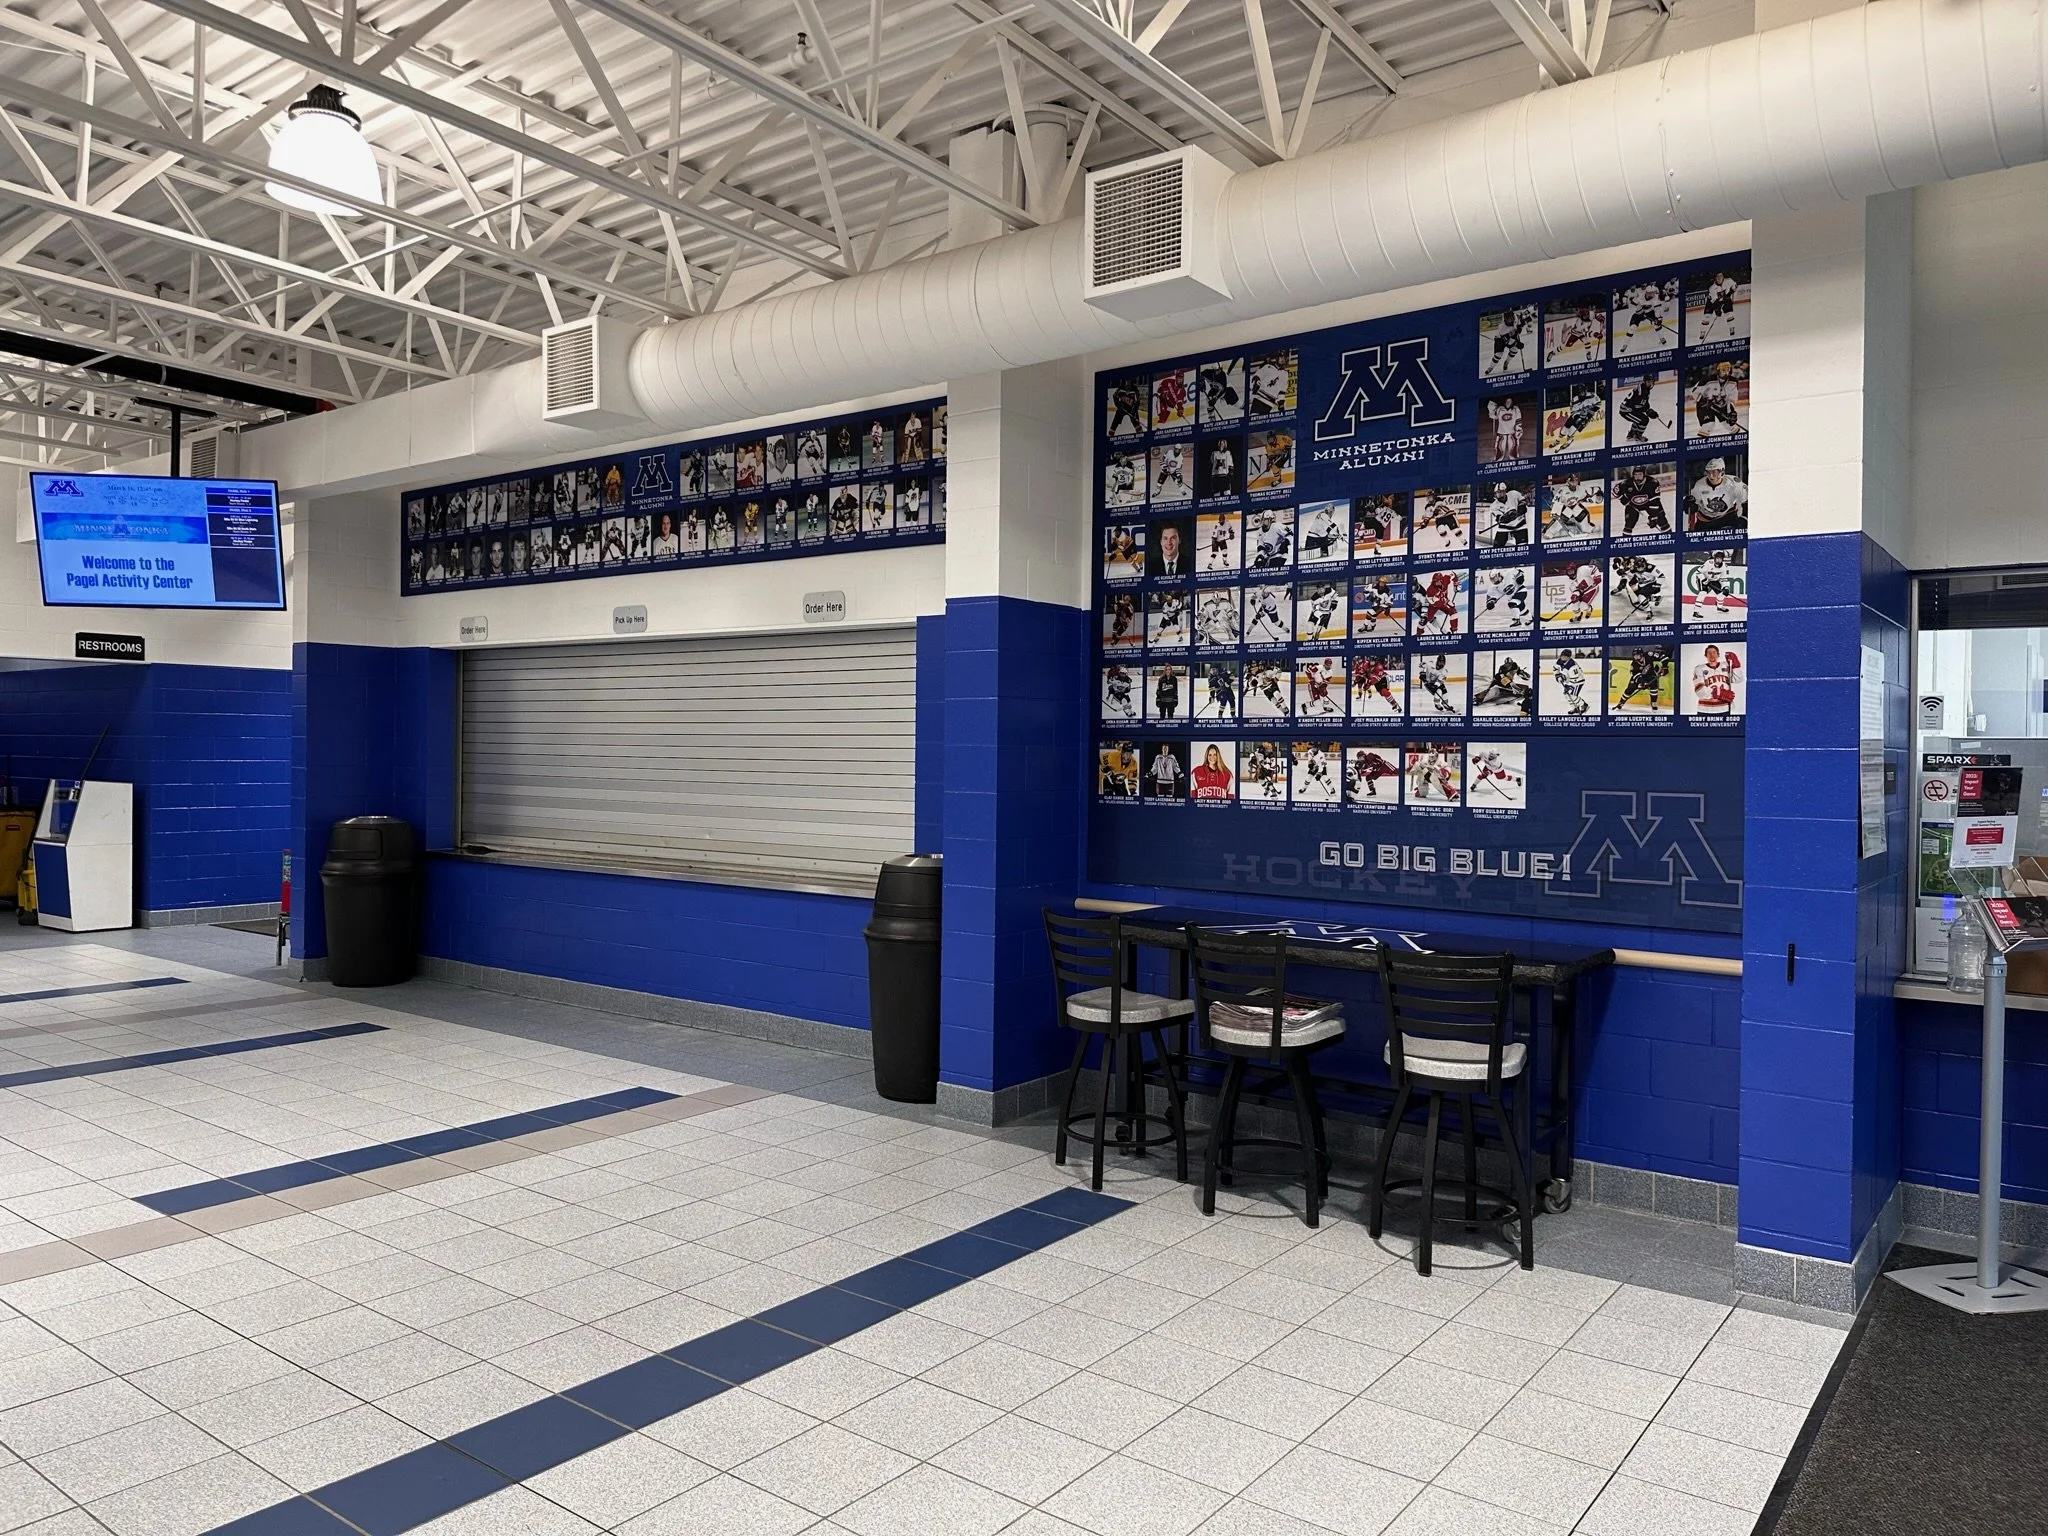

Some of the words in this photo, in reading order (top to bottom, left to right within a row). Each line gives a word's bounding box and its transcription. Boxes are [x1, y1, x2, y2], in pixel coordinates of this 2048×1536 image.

[1688, 350, 1715, 358] UNIVERSITY
[1547, 371, 1571, 379] UNIVERSITY
[1314, 432, 1455, 461] MINNETONKA
[1339, 450, 1424, 470] ALUMNI
[632, 496, 673, 505] MINNETONKA
[1444, 495, 1468, 504] CME
[82, 555, 136, 570] Welcome
[138, 557, 152, 570] to
[154, 557, 174, 571] the
[67, 573, 99, 587] Pagel
[102, 574, 149, 589] Activity
[153, 575, 193, 589] Center
[805, 601, 824, 614] Order
[826, 600, 842, 612] Here
[615, 615, 625, 624] Pick
[626, 615, 634, 625] Up
[635, 614, 645, 624] Here
[461, 624, 473, 635] Order
[473, 624, 486, 634] Here
[78, 640, 142, 654] RESTROOMS
[1927, 756, 1971, 764] SPARX
[1198, 786, 1226, 798] BOSTON
[1319, 840, 1364, 868] GO
[1377, 844, 1436, 872] BIG
[1450, 848, 1571, 881] BLUE!
